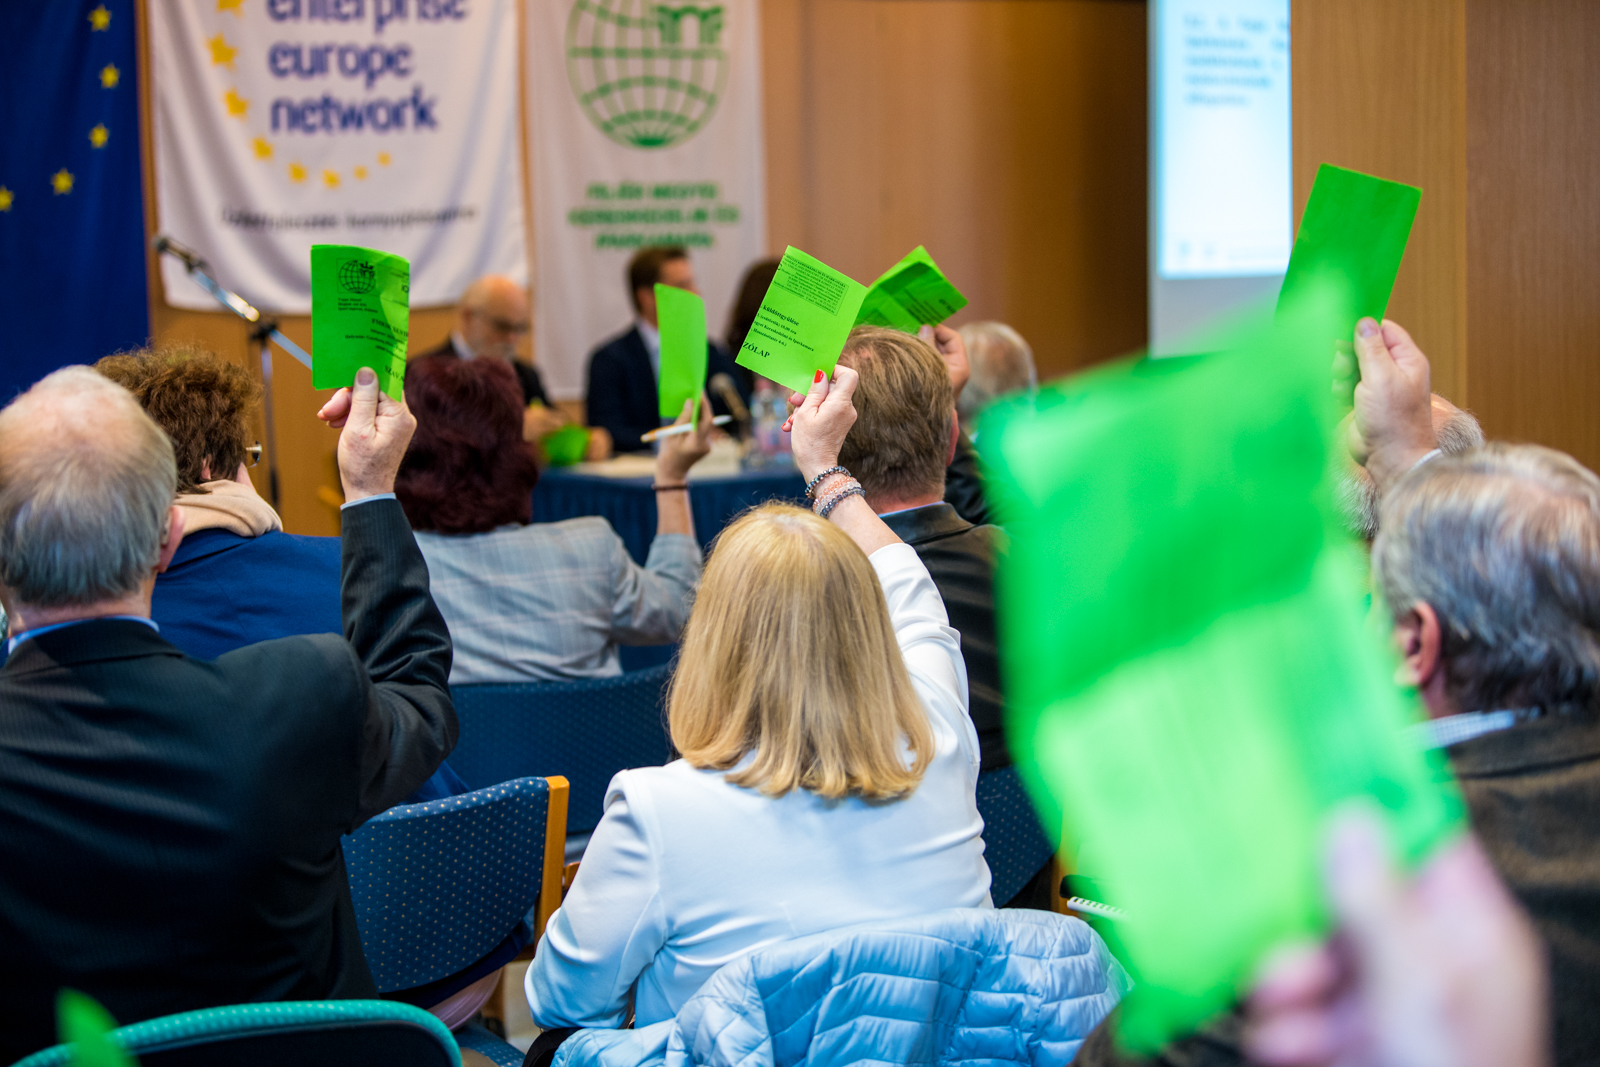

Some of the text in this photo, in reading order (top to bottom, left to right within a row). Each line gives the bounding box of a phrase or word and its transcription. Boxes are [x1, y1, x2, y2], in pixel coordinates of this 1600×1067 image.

[268, 43, 412, 89] europe
[270, 85, 438, 132] network
[742, 341, 770, 358] ZÓLAP
